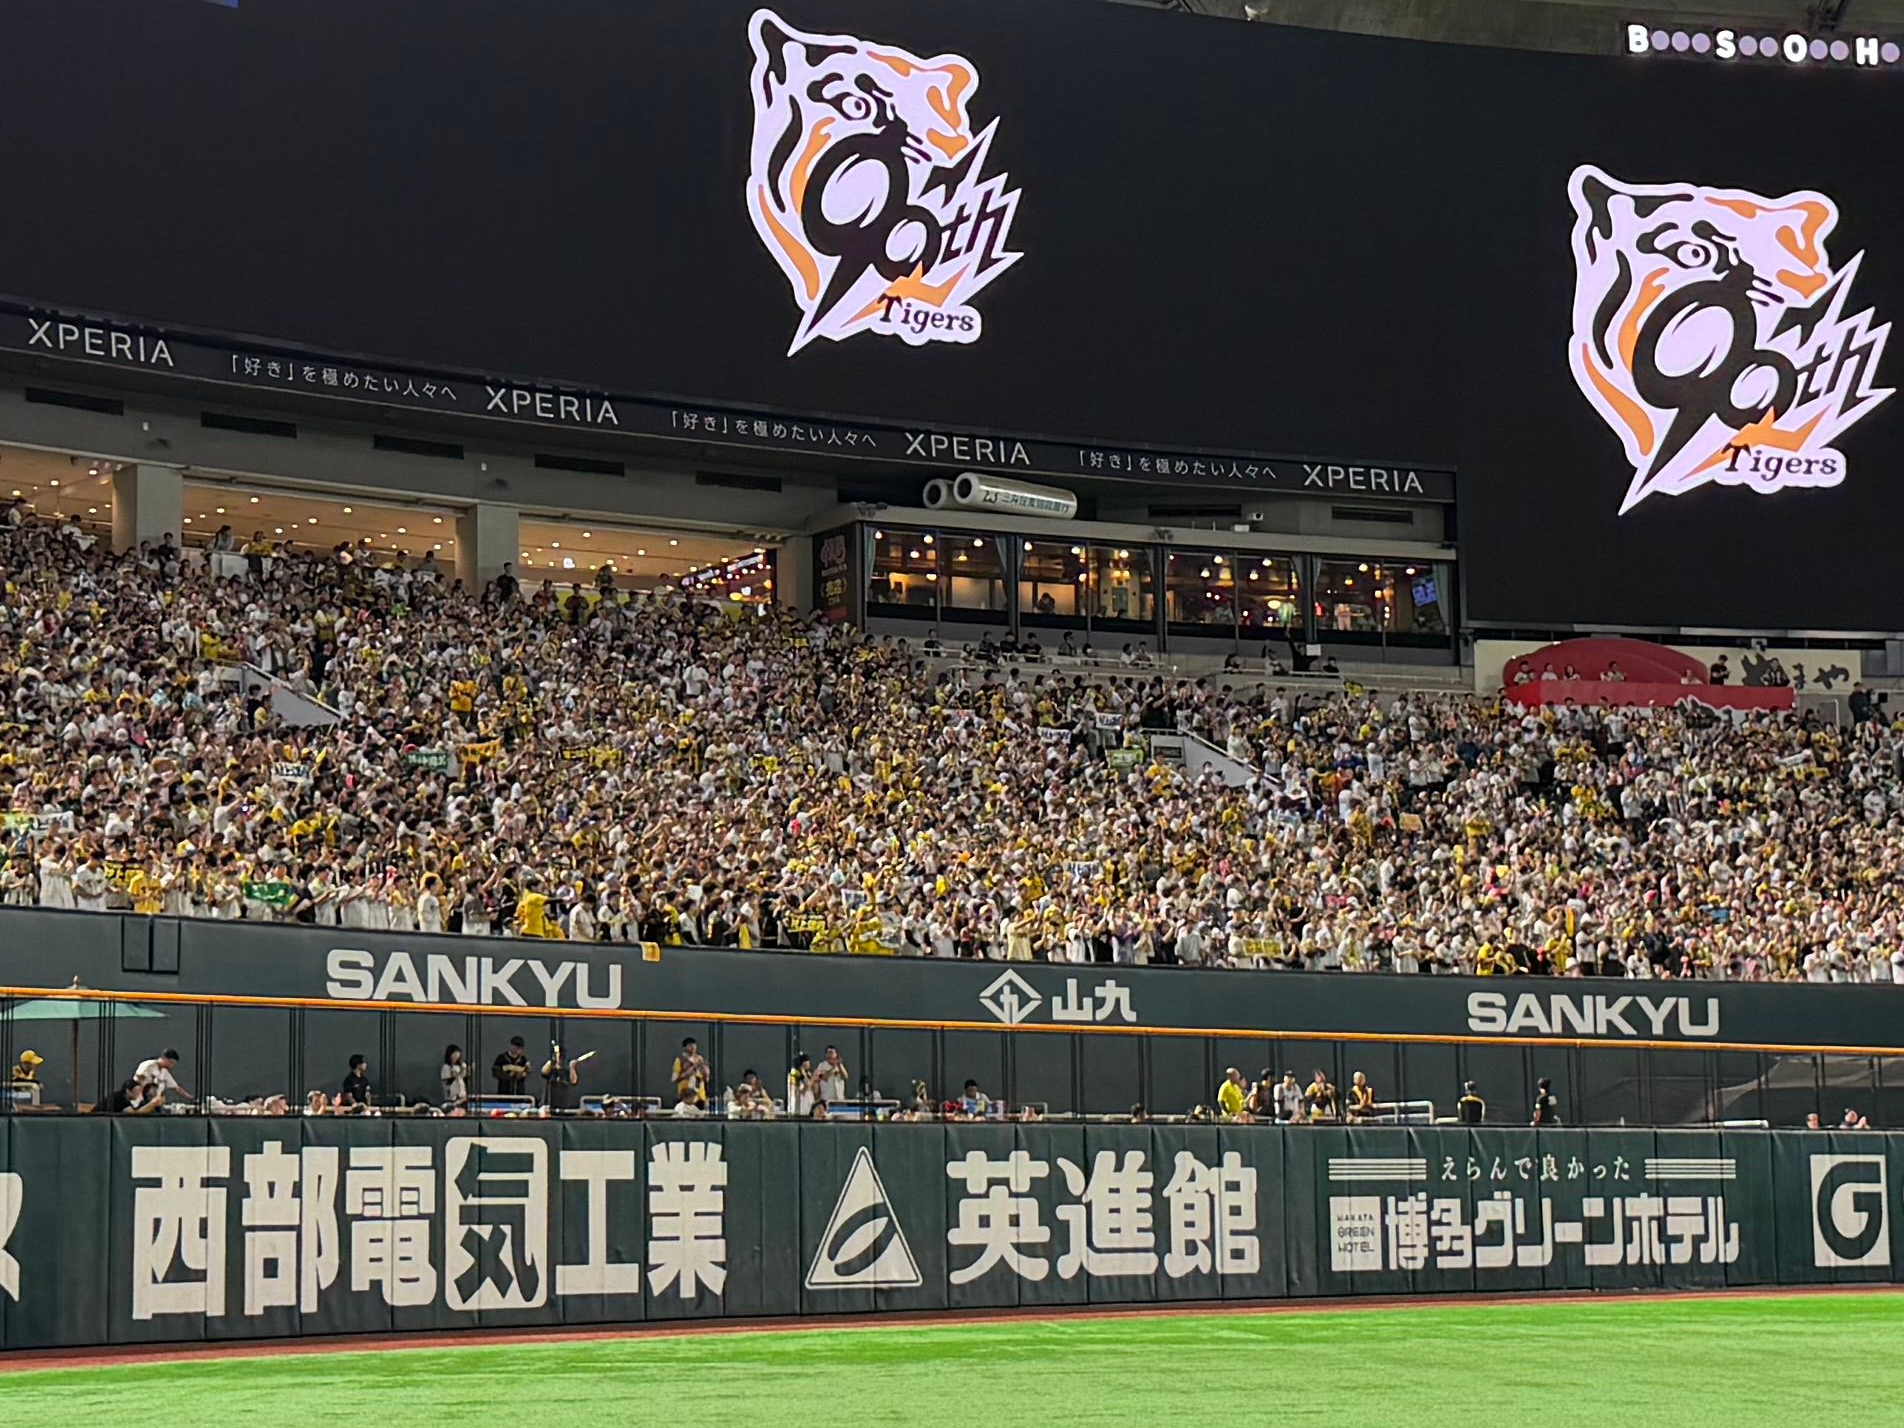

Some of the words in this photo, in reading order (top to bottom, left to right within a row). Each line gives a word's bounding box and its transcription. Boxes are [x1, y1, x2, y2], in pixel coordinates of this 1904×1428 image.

[1627, 24, 1650, 54] B
[1715, 30, 1737, 59] S
[1855, 38, 1880, 66] H
[877, 293, 975, 335] Tigers
[28, 317, 174, 368] XPERIA
[485, 385, 619, 425] XPERIA
[905, 431, 1031, 466] XPERIA
[1302, 464, 1424, 494] XPERIA
[1721, 442, 1838, 483] Tigers
[326, 948, 623, 1011] SANKYU
[1051, 976, 1138, 1023] 山九
[1467, 991, 1721, 1037] SANKYU
[1440, 1154, 1632, 1182] えらんで良かった
[130, 1135, 729, 1320] 西部電気工業
[946, 1150, 1261, 1285] 英進館
[1385, 1190, 1740, 1271] 博多グリーンホテル
